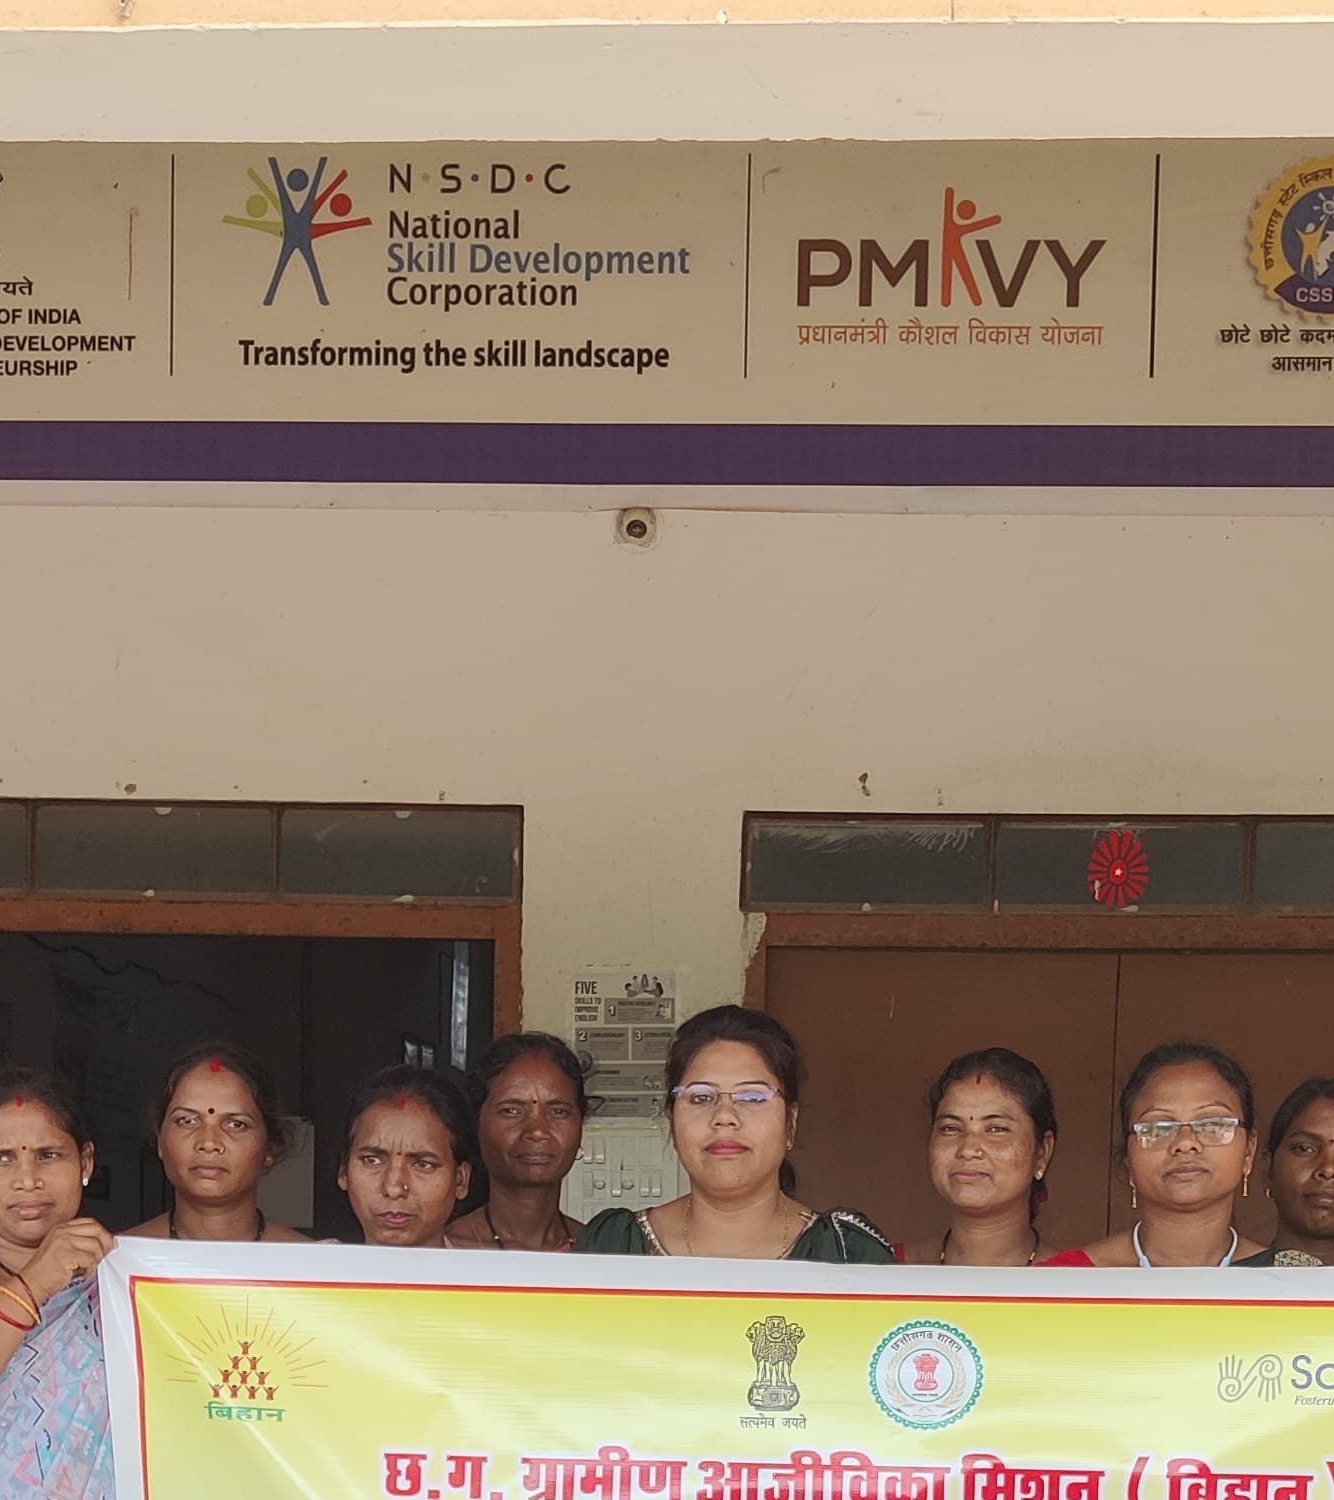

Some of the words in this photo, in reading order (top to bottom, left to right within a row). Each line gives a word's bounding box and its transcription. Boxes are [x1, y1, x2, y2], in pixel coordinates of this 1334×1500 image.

[388, 209, 520, 239] National
[797, 187, 1107, 308] PMKVY
[387, 243, 455, 274] Skill
[469, 243, 690, 281] Development
[387, 277, 578, 312] Corporation
[28, 308, 81, 326] INDIA
[798, 317, 888, 346] प्रधानमंत्री
[899, 319, 958, 346] कौशल
[967, 319, 1031, 346] विकास
[1040, 319, 1103, 346] योजना
[1220, 324, 1252, 345] छोटे
[1260, 324, 1292, 345] छोटे
[238, 340, 415, 374] Transforming
[424, 340, 466, 368] the
[473, 340, 527, 367] skill
[534, 340, 669, 375] landscape
[1272, 356, 1334, 372] आसमान
[574, 981, 598, 995] FIVE
[608, 1005, 616, 1017] 1
[578, 1030, 588, 1042] 2
[634, 1030, 643, 1042] 3
[205, 1402, 285, 1423] बिहान
[739, 1413, 775, 1430] सत्यमेव
[781, 1414, 807, 1430] जयते
